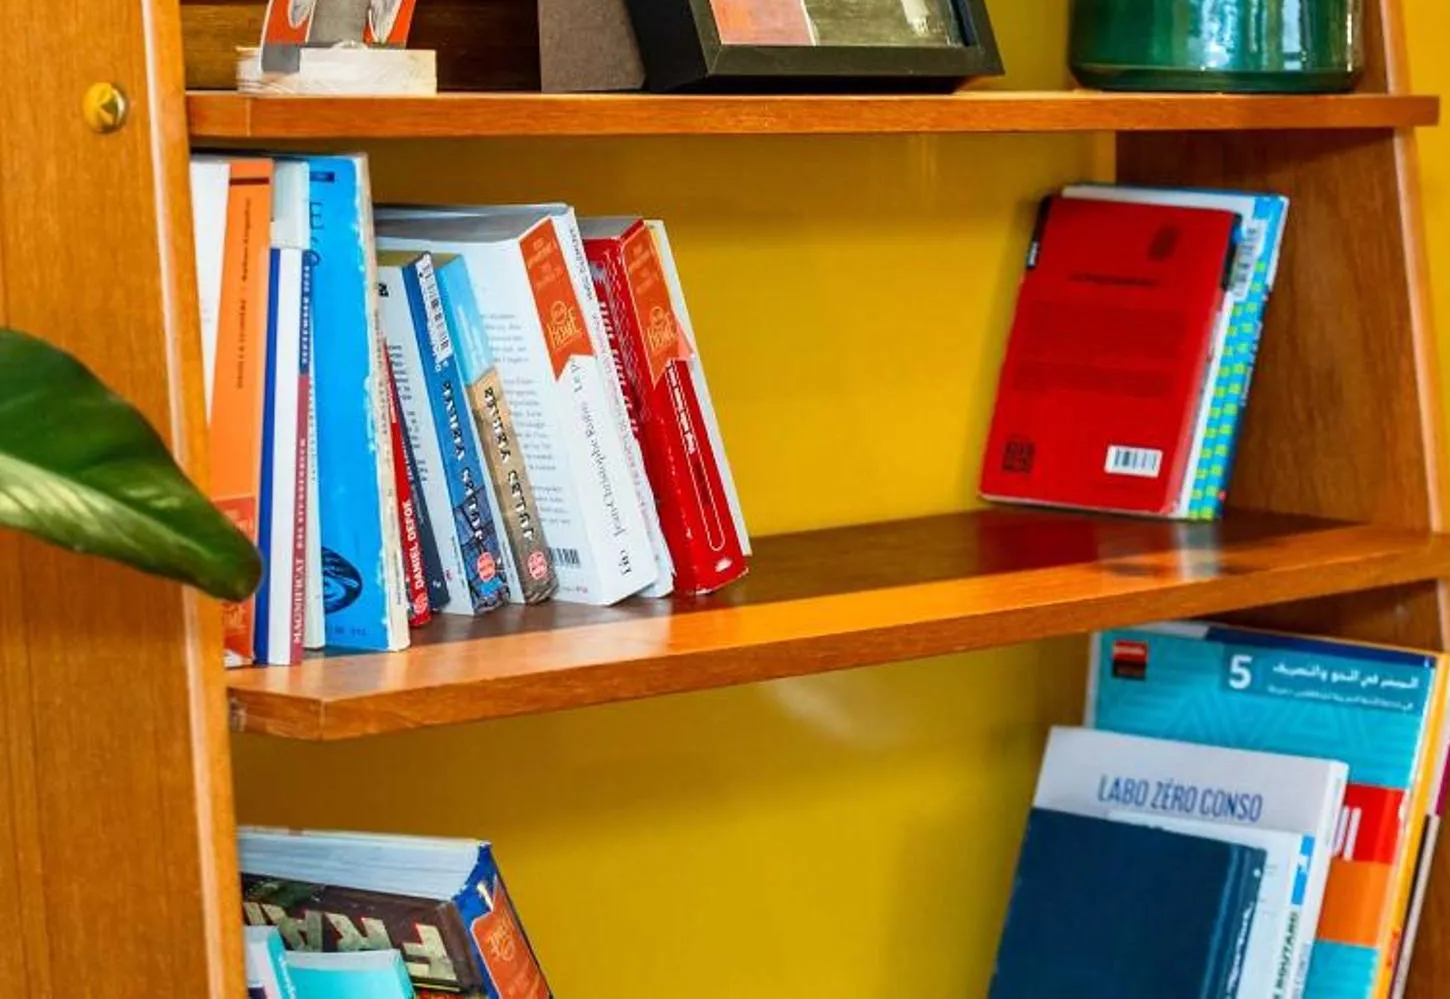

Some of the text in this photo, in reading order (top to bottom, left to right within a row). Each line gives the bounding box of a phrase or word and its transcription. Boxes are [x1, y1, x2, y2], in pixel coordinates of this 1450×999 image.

[484, 386, 512, 463] VERNE
[442, 380, 484, 540] JULES VERNE
[402, 500, 417, 542] DEFOE
[507, 469, 534, 541] JULES
[409, 543, 425, 590] DANIEL
[292, 557, 304, 645] MAGNIFICAT
[1228, 654, 1254, 690] 5
[1097, 773, 1264, 823] LABO ZÉRO CONSO
